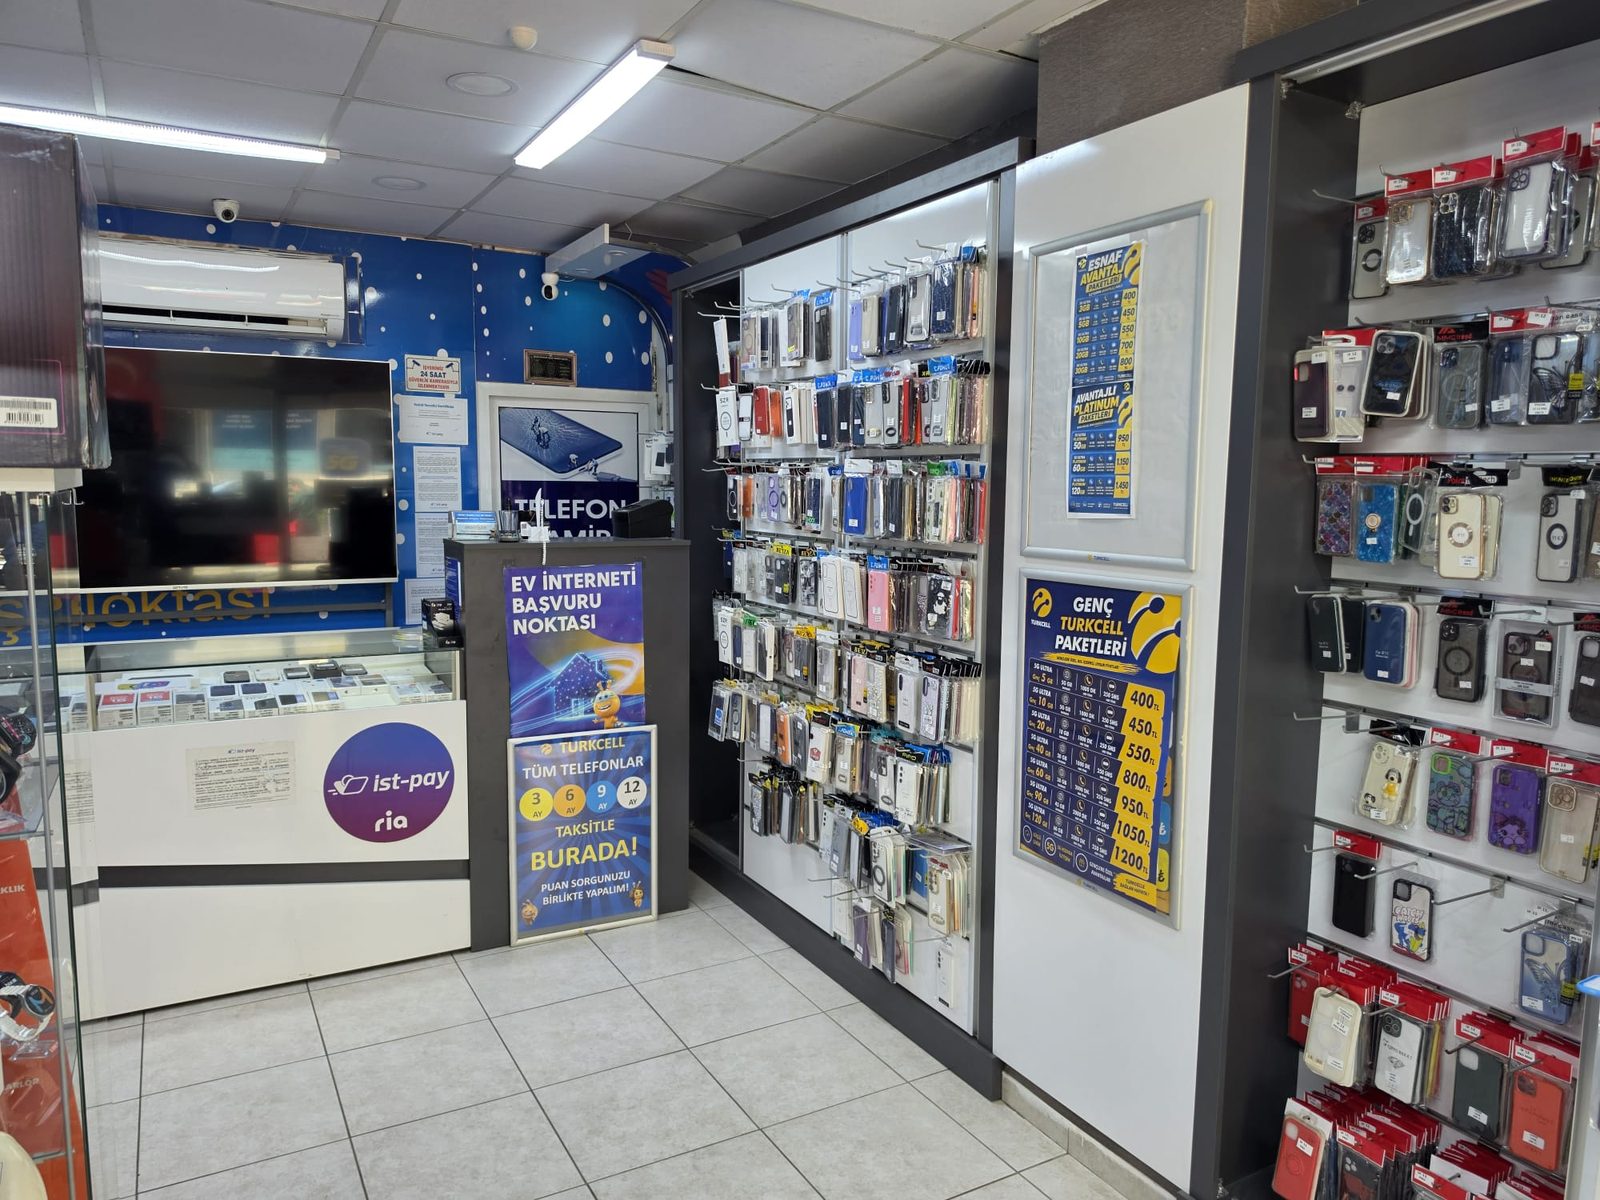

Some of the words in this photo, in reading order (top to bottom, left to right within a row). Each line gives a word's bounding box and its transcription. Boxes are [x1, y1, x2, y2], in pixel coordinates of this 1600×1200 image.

[1088, 249, 1123, 271] ESNAF
[1124, 291, 1136, 299] 400
[1122, 308, 1135, 317] 450
[1122, 324, 1134, 334] 550
[1121, 341, 1133, 350] 700
[1120, 357, 1132, 366] 800
[1118, 434, 1129, 442] 950
[514, 499, 626, 520] TLEFON
[511, 576, 537, 592] EV
[542, 566, 636, 591] İNTERNETİ
[512, 593, 602, 614] BAŞVURU
[1073, 596, 1114, 618] GENÇ
[513, 614, 596, 635] NOKTASI
[1030, 619, 1051, 629] TURKCELL
[1060, 616, 1124, 636] TURKCELL
[1055, 634, 1128, 657] PAKETLERİ
[1040, 665, 1052, 673] ULTRA
[1041, 673, 1046, 682] 5
[1038, 688, 1052, 697] ULTRA
[1038, 696, 1046, 706] 10
[1037, 712, 1051, 721] ULTRA
[1037, 719, 1046, 730] 20
[1109, 719, 1118, 727] SMS
[559, 737, 625, 754] TURKCELL
[1036, 736, 1048, 745] ULTRA
[1036, 743, 1044, 754] 40
[1108, 745, 1116, 753] SMS
[522, 765, 556, 780] TÜM
[560, 755, 644, 776] TELEFONLAR
[1036, 759, 1048, 768] ULTRA
[1035, 767, 1044, 778] 60
[373, 770, 450, 792] ist-pay
[532, 792, 541, 805] 3
[565, 788, 575, 801] 6
[597, 785, 606, 798] 9
[624, 780, 641, 794] 12
[1036, 782, 1047, 792] ULTRA
[1034, 790, 1042, 802] 90
[1104, 796, 1112, 804] SMS
[532, 810, 543, 818] AY
[628, 798, 637, 806] AY
[1033, 804, 1045, 815] ULTRA
[374, 810, 408, 832] ria
[1032, 812, 1042, 825] 120
[555, 819, 615, 838] TAKSİTLE
[1101, 822, 1110, 830] SMS
[531, 836, 638, 871] BURADA!
[1100, 847, 1108, 856] SMS
[541, 880, 570, 892] PUAN
[571, 870, 631, 888] SORGUNUZU
[542, 892, 583, 906] BİRLİKTE
[585, 884, 629, 899] YAPALIM!
